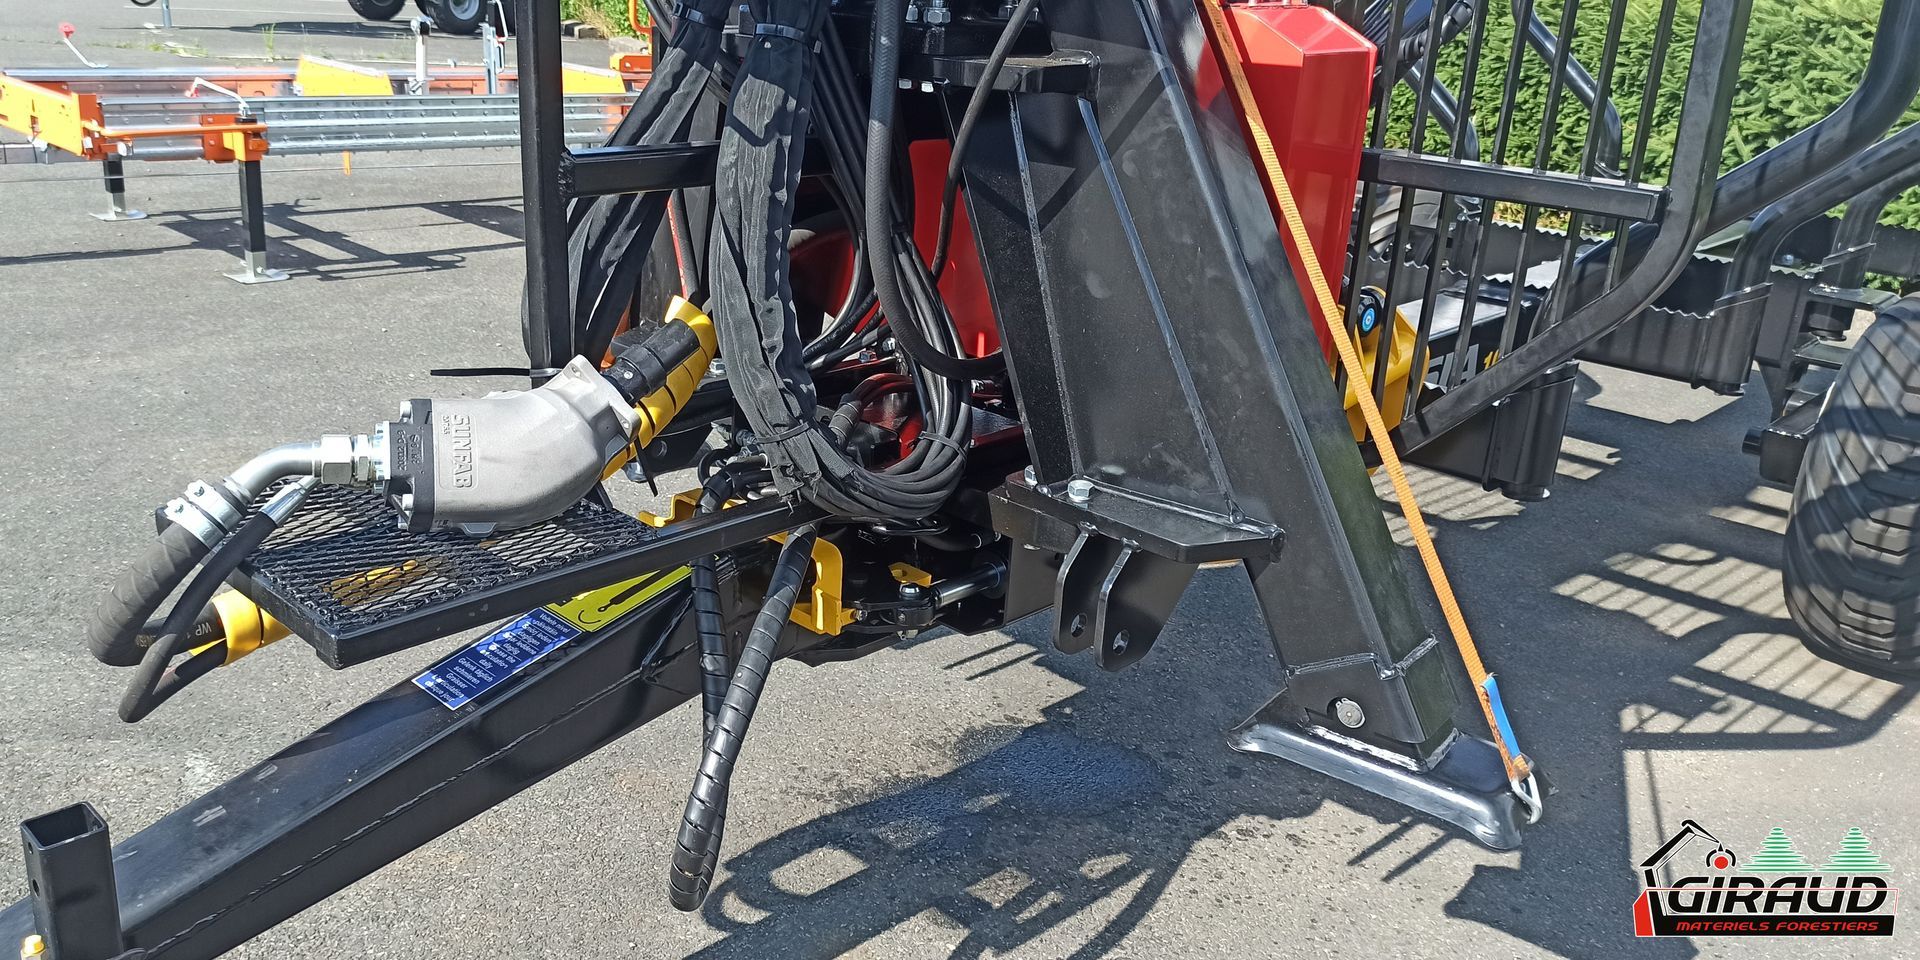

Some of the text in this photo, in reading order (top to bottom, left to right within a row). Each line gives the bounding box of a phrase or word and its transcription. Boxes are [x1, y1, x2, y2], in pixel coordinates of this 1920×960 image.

[453, 414, 474, 488] SUNFAB
[195, 622, 212, 636] WP
[458, 658, 493, 682] Gelenk täglich
[479, 659, 493, 669] daily
[446, 674, 468, 688] Graisser
[454, 666, 480, 685] schmieren
